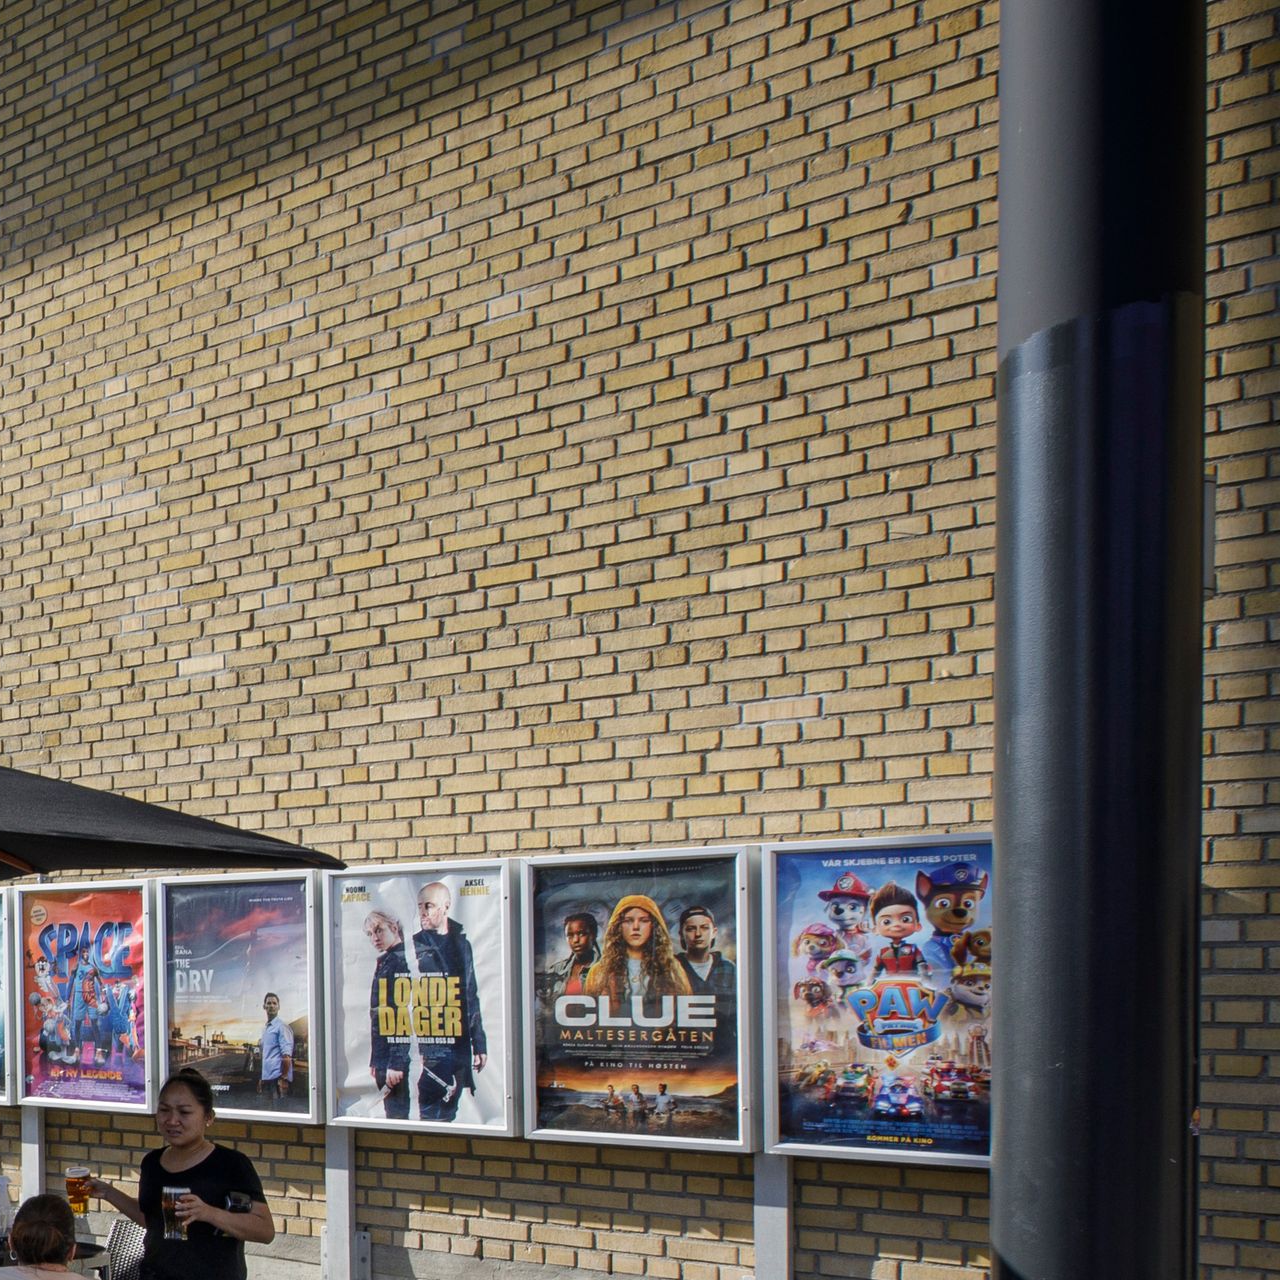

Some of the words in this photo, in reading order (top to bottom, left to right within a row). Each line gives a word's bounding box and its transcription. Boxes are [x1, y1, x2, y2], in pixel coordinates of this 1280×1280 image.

[843, 857, 886, 867] SKJEBNE
[888, 856, 901, 865] ER
[909, 855, 941, 864] DERES
[943, 853, 977, 862] POTER
[464, 879, 485, 887] AKSEL
[460, 886, 491, 897] HENNIE
[38, 921, 134, 980] SPACE
[175, 958, 191, 968] THE
[175, 969, 215, 993] DRY
[378, 977, 387, 1007] I
[393, 976, 461, 1008] ONDE
[847, 986, 951, 1022] PAW
[555, 995, 717, 1028] CLUE
[378, 1006, 463, 1037] DAGER
[559, 1028, 714, 1042] MALTESERGÅTEN
[80, 1069, 124, 1081] LEGENDE
[866, 1135, 899, 1143] KOMMER
[913, 1137, 934, 1145] KINO
